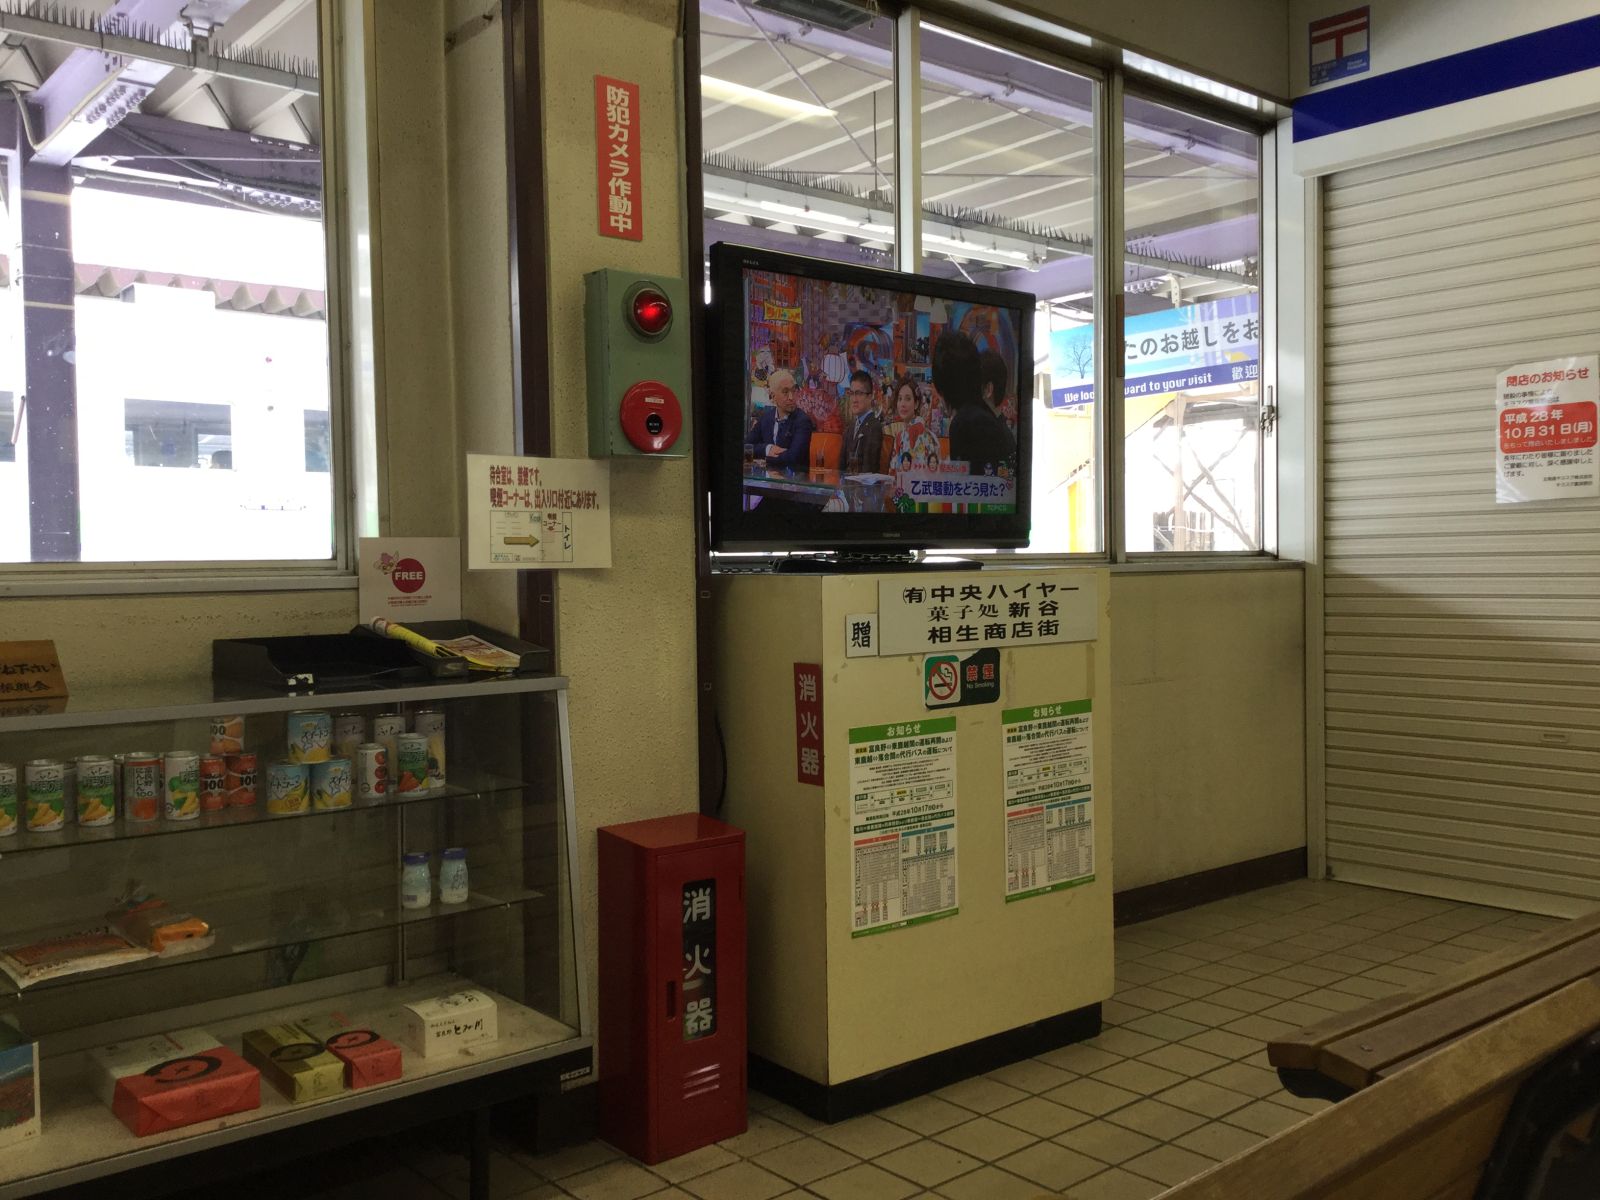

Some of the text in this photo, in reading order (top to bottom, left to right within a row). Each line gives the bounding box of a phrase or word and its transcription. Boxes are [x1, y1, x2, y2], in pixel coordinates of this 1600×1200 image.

[606, 85, 632, 232] 防犯カメラ作動中
[1506, 368, 1589, 387] 閉店のお知らせ
[1064, 393, 1078, 403] We
[1149, 381, 1160, 391] to
[1163, 378, 1187, 392] your
[1188, 373, 1212, 385] visit
[1504, 409, 1564, 424] 平成28年
[1504, 421, 1593, 439] 10月31日(月)
[911, 480, 1005, 496] 乙武騒動をどう見た?
[395, 571, 423, 580] FREE
[852, 620, 872, 648] 贈
[927, 619, 1060, 644] 相生商店街
[966, 663, 995, 682] 禁煙
[1033, 705, 1062, 718] お知らせ
[798, 673, 820, 776] 消火器
[886, 724, 921, 737] お知らせ
[682, 887, 713, 1034] 消火器
